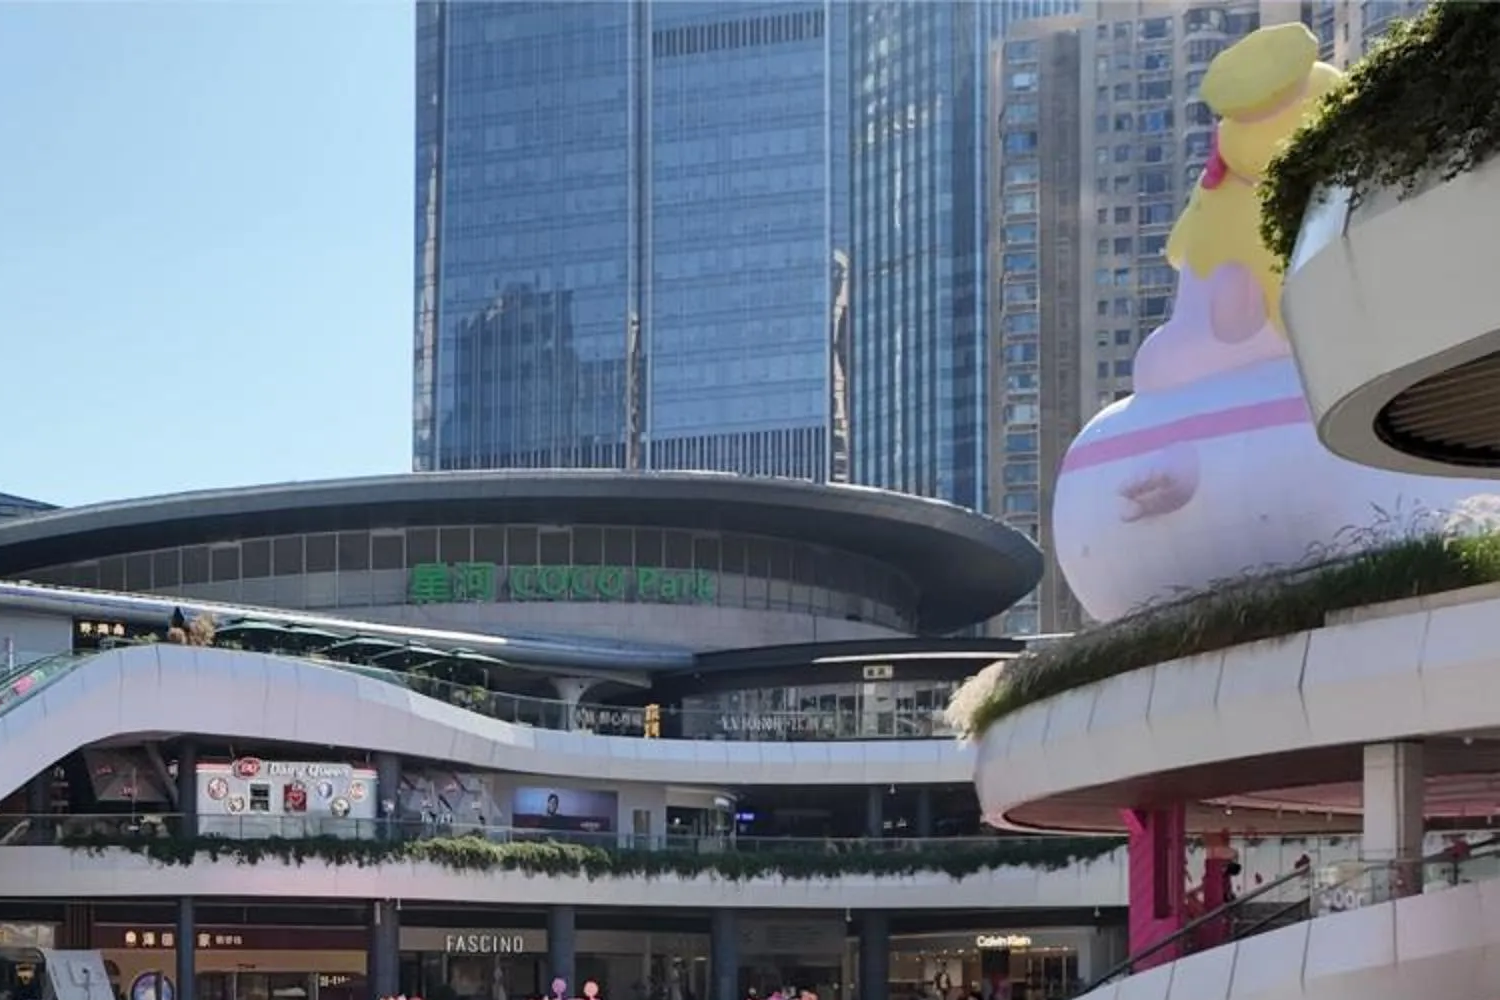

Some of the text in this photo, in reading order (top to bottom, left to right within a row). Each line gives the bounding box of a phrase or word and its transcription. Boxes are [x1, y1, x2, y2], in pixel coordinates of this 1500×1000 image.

[411, 562, 716, 602] 星河 COCO Park
[446, 935, 523, 953] FASCINO
